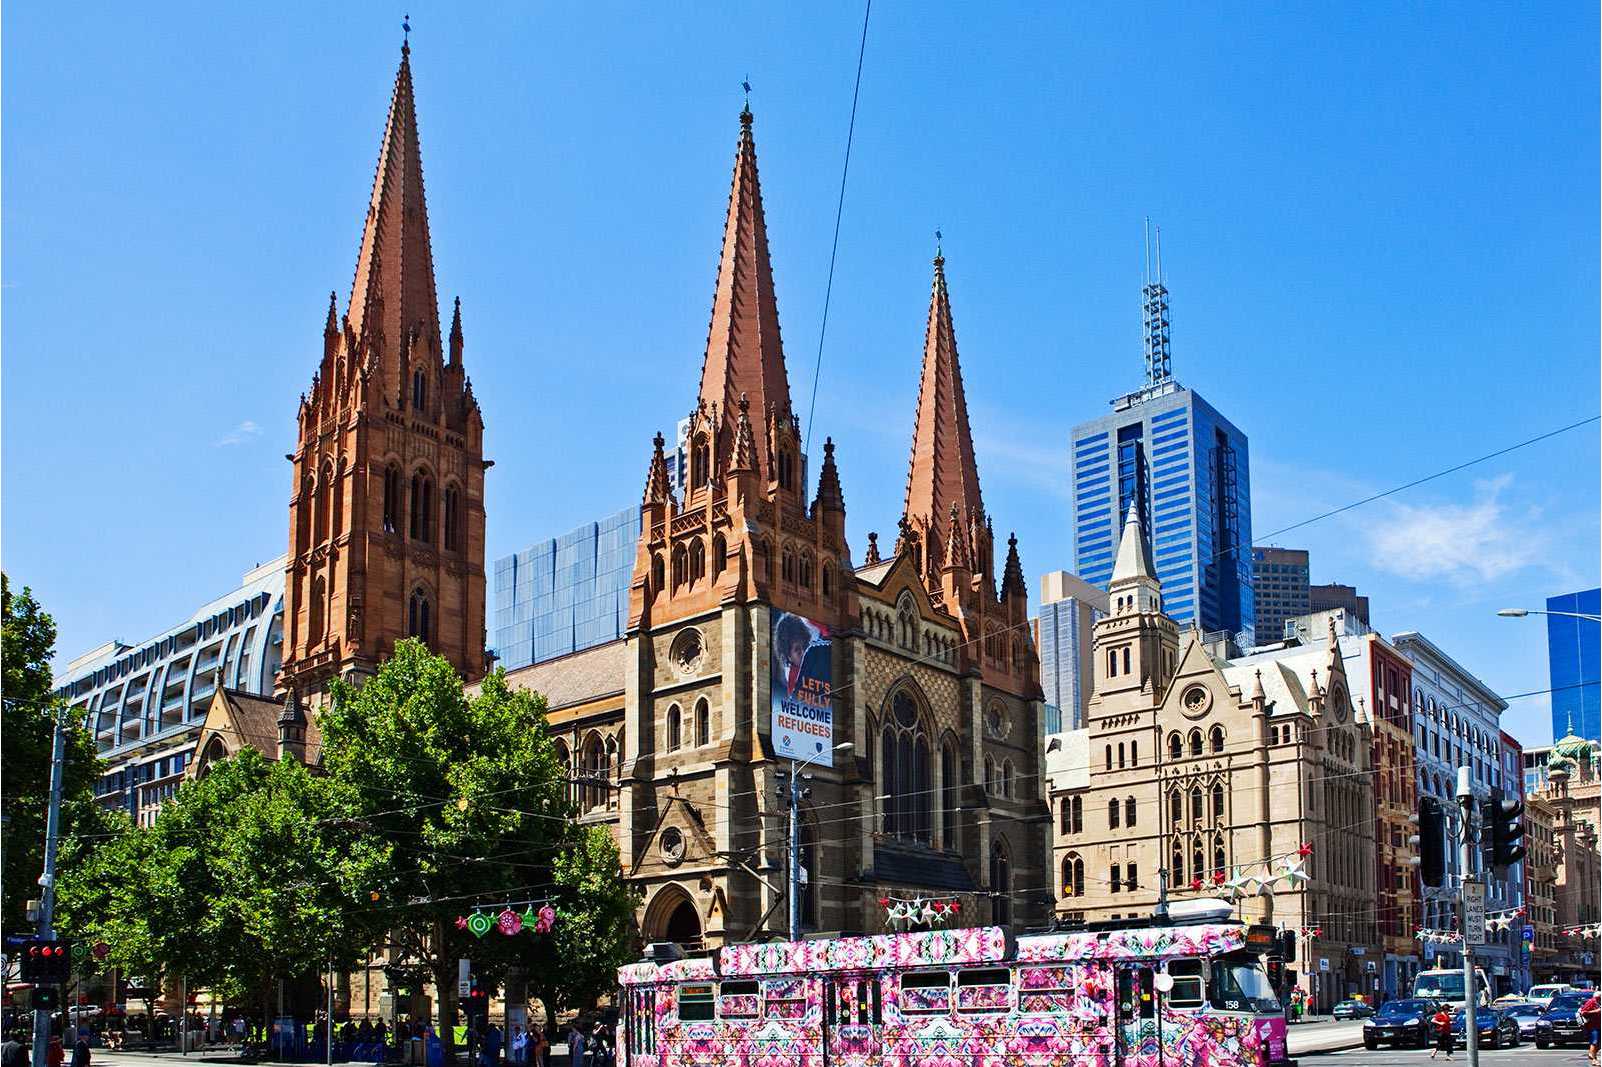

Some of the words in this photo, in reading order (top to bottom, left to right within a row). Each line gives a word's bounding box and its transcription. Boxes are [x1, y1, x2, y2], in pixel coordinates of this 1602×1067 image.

[802, 676, 831, 695] LET'S
[796, 690, 831, 708] FULLY
[781, 700, 831, 724] WELCOME
[778, 715, 831, 738] REFUGEES
[1466, 905, 1483, 913] LANES
[1225, 1000, 1239, 1009] 158
